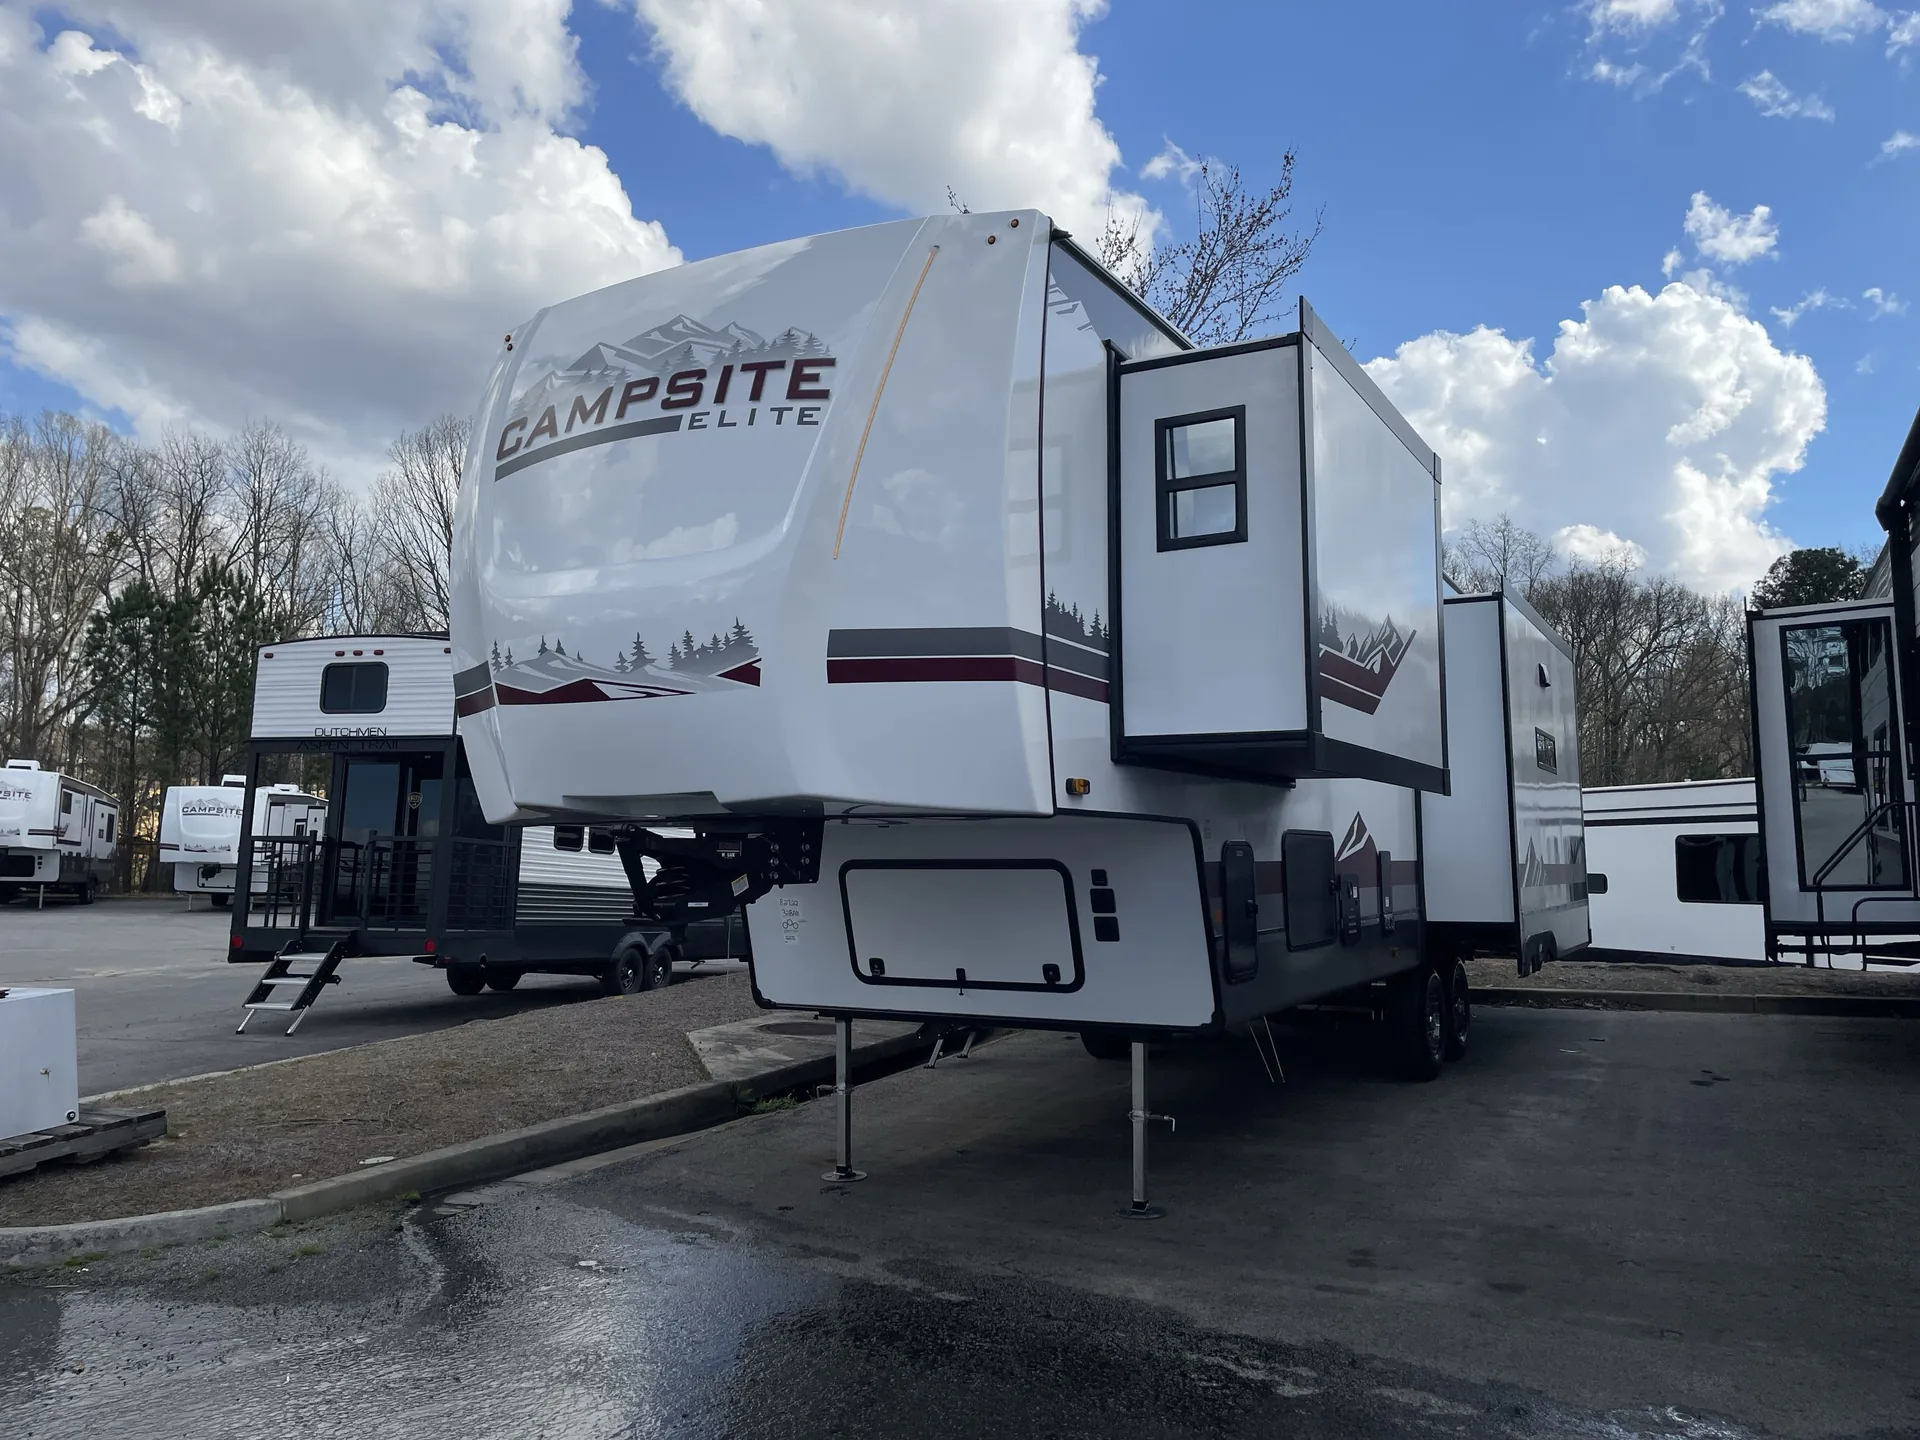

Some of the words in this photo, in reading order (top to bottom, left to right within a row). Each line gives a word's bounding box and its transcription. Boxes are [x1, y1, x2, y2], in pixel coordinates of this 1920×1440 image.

[497, 357, 836, 461] CAMPSITE
[687, 406, 821, 430] ELITE
[314, 727, 387, 737] DUTCHMEN
[296, 740, 349, 751] ASPEN
[182, 806, 243, 816] CAMPSITE
